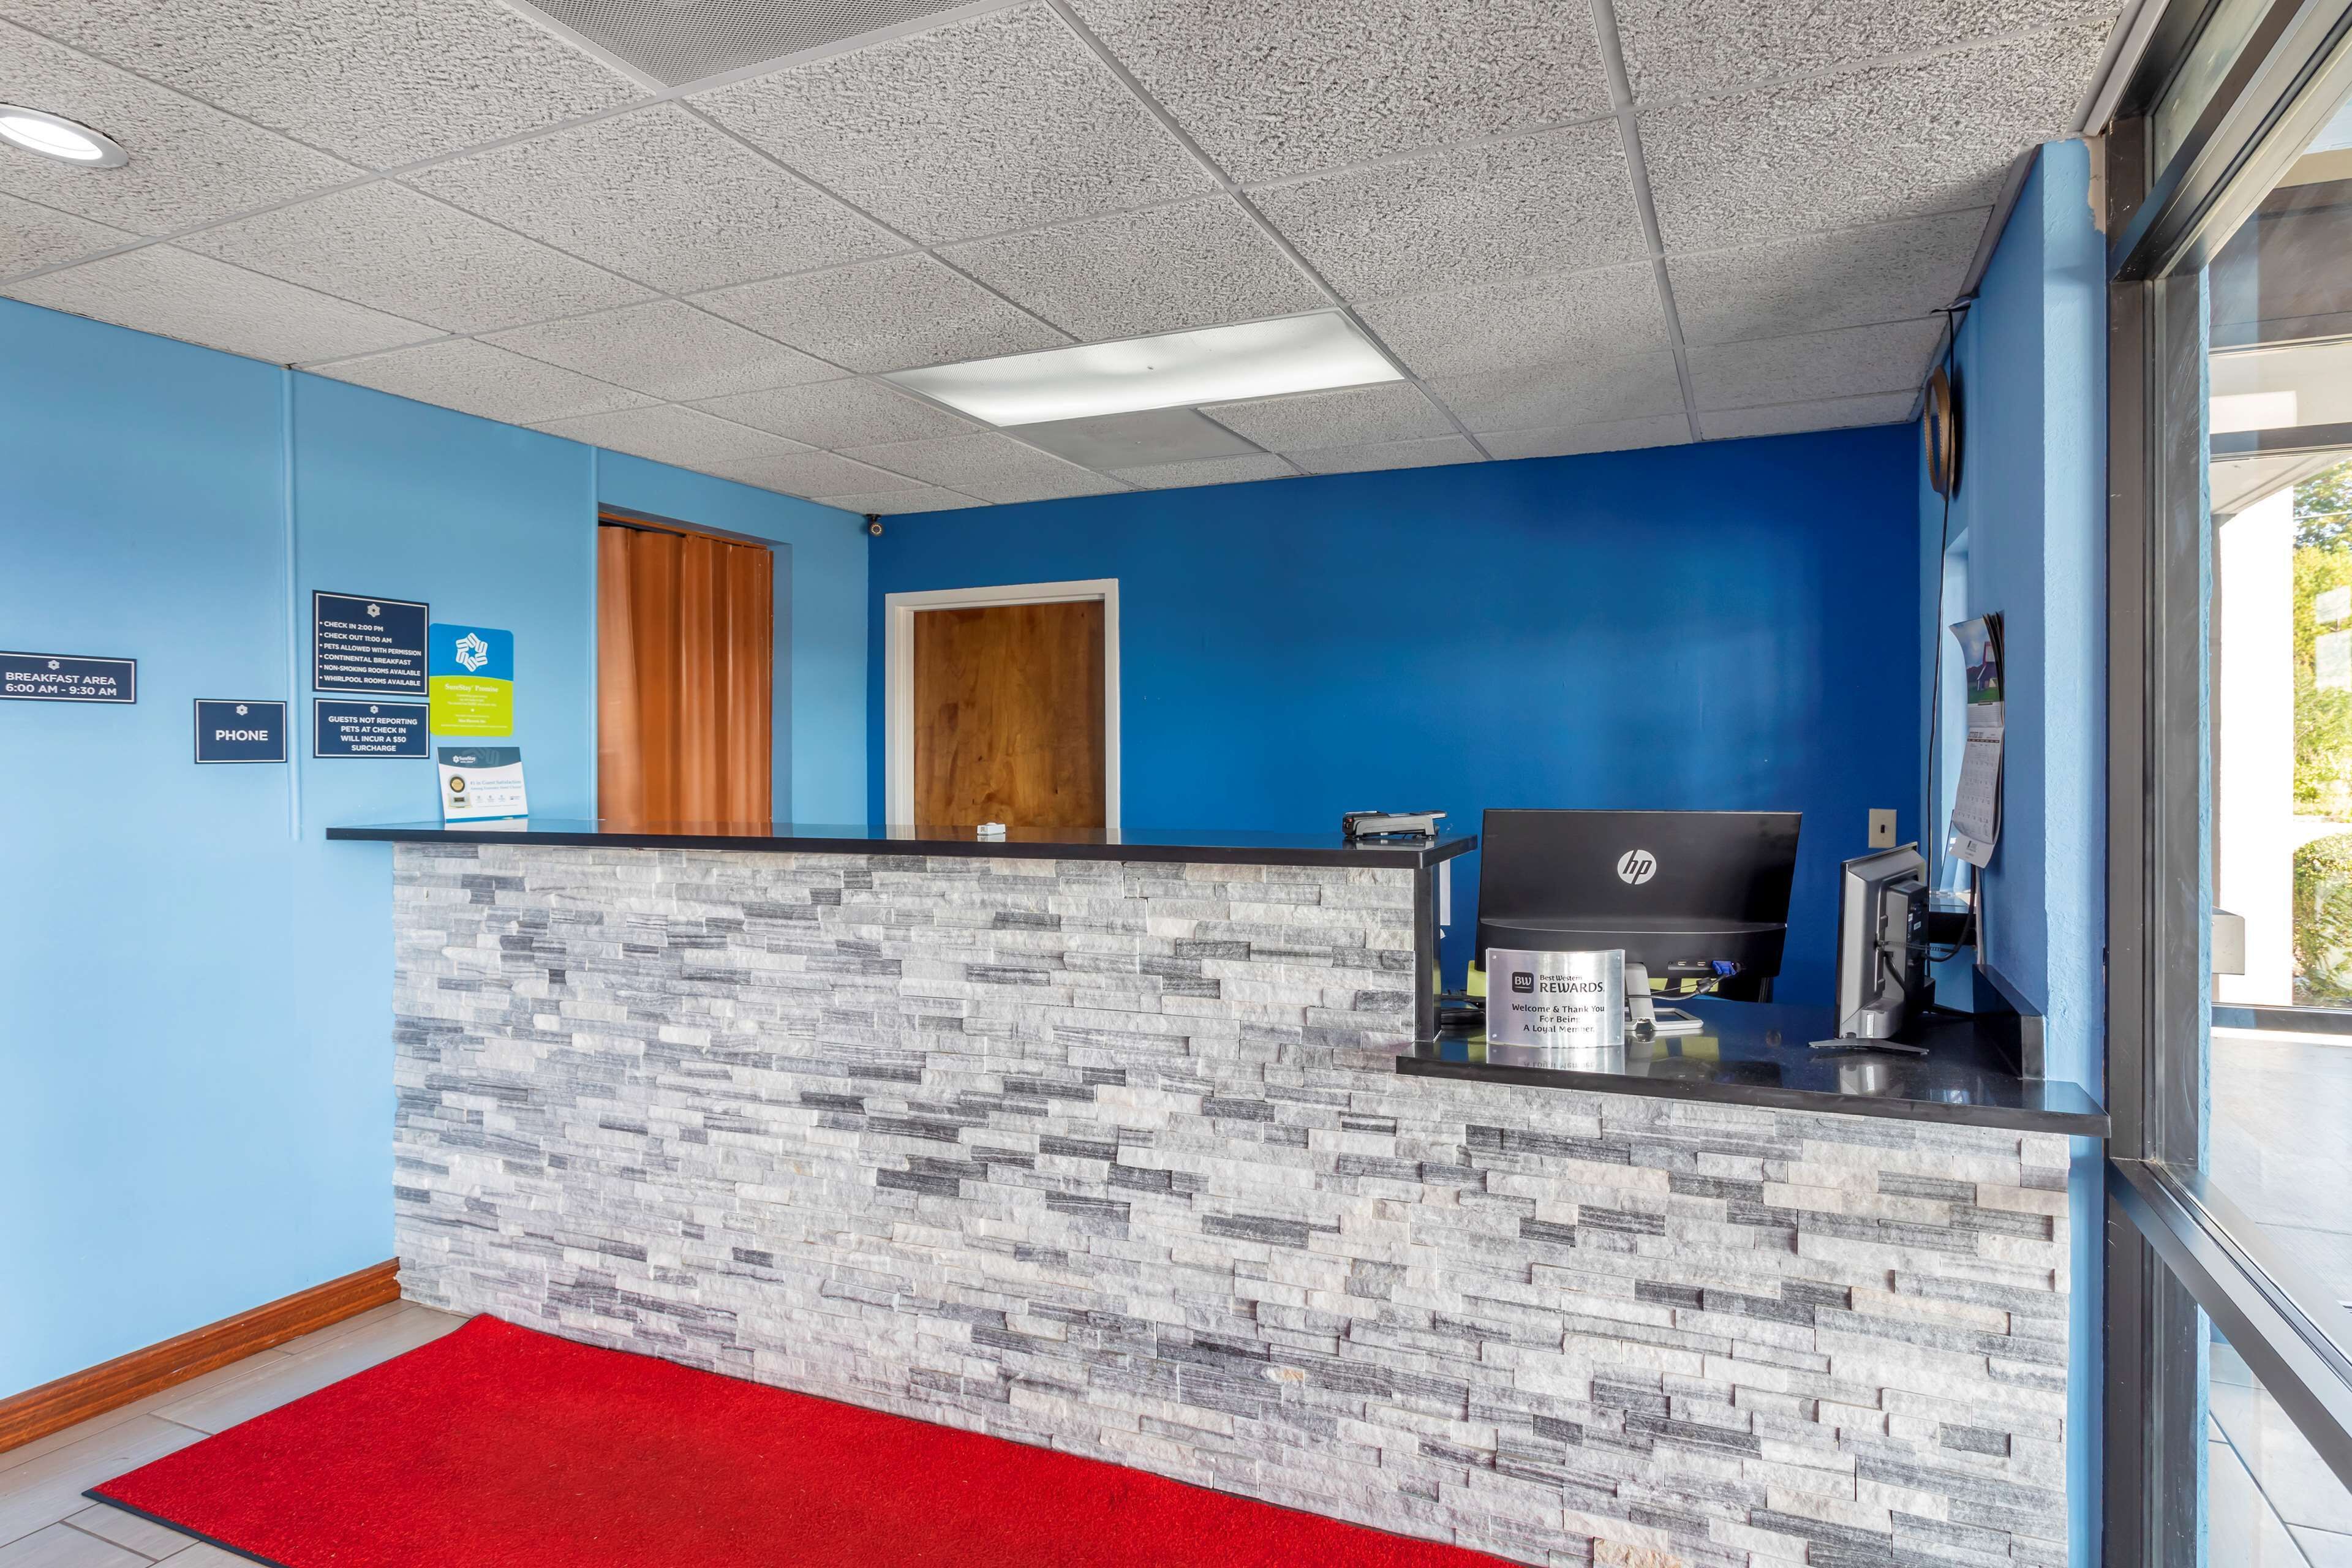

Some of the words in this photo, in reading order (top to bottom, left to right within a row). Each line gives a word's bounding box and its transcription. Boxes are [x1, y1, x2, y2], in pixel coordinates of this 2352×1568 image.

[323, 654, 372, 663] CONTINENTAL
[5, 672, 80, 684] BREAKFAST
[83, 676, 116, 685] AREA
[5, 684, 35, 693] 6:00
[38, 685, 58, 693] AM
[69, 686, 95, 695] 9:30
[98, 687, 117, 696] AM
[216, 730, 268, 741] PHONE
[1622, 850, 1653, 884] hp
[1514, 976, 1531, 986] BW
[1512, 1003, 1550, 1012] Welcome
[1532, 1025, 1556, 1034] Loyal
